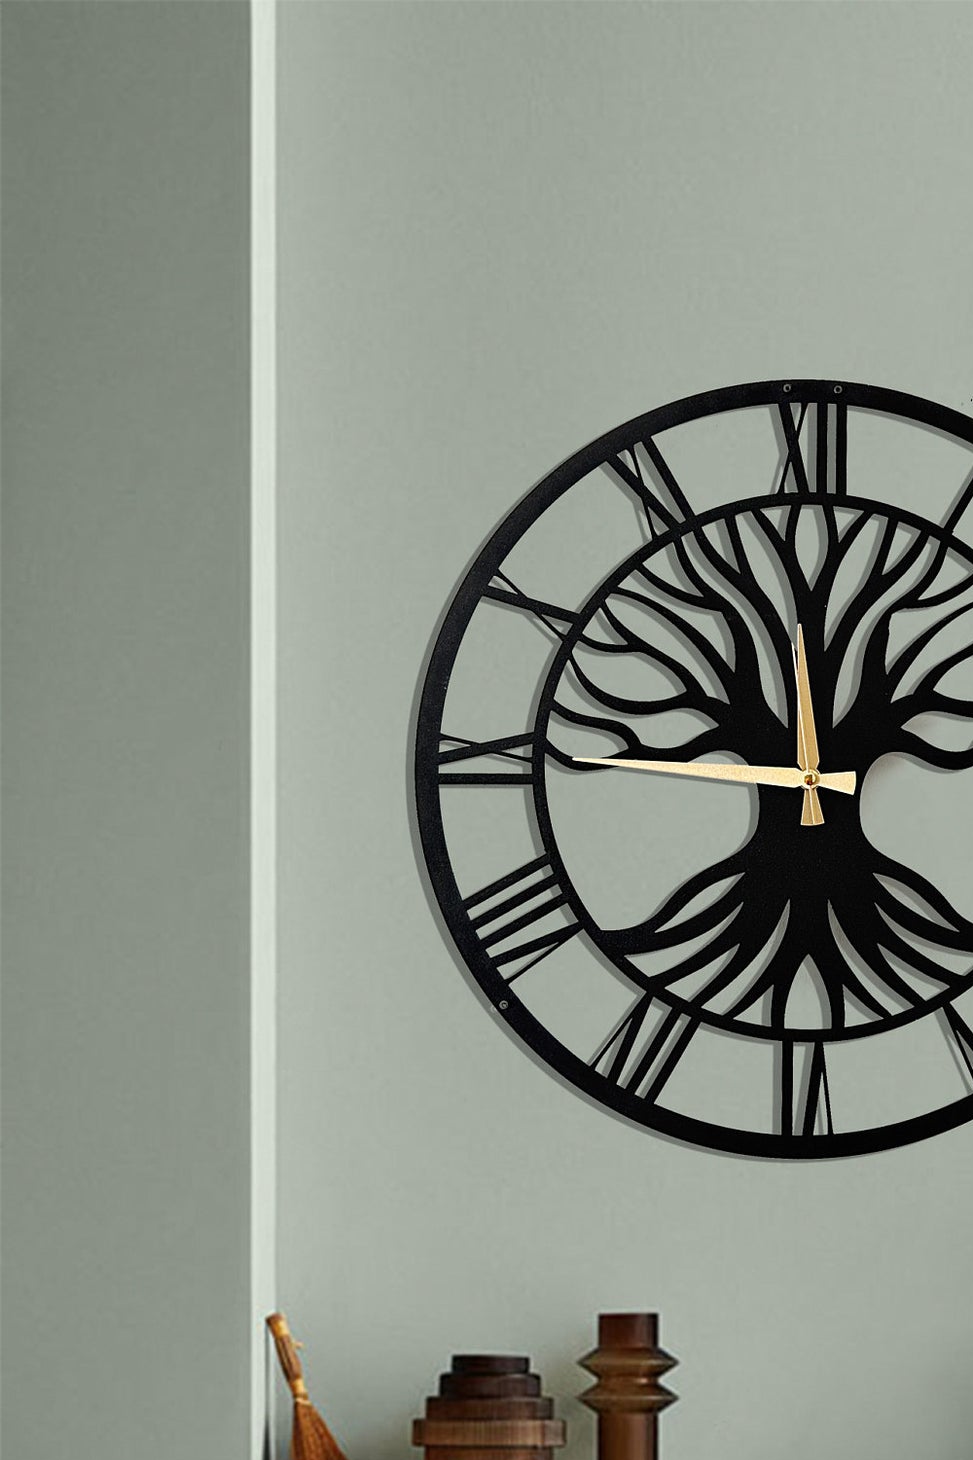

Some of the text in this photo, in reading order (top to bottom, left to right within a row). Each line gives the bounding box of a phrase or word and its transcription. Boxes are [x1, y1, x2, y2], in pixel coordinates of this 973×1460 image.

[605, 436, 695, 541] XI
[777, 402, 847, 495] XII
[482, 566, 583, 642] X
